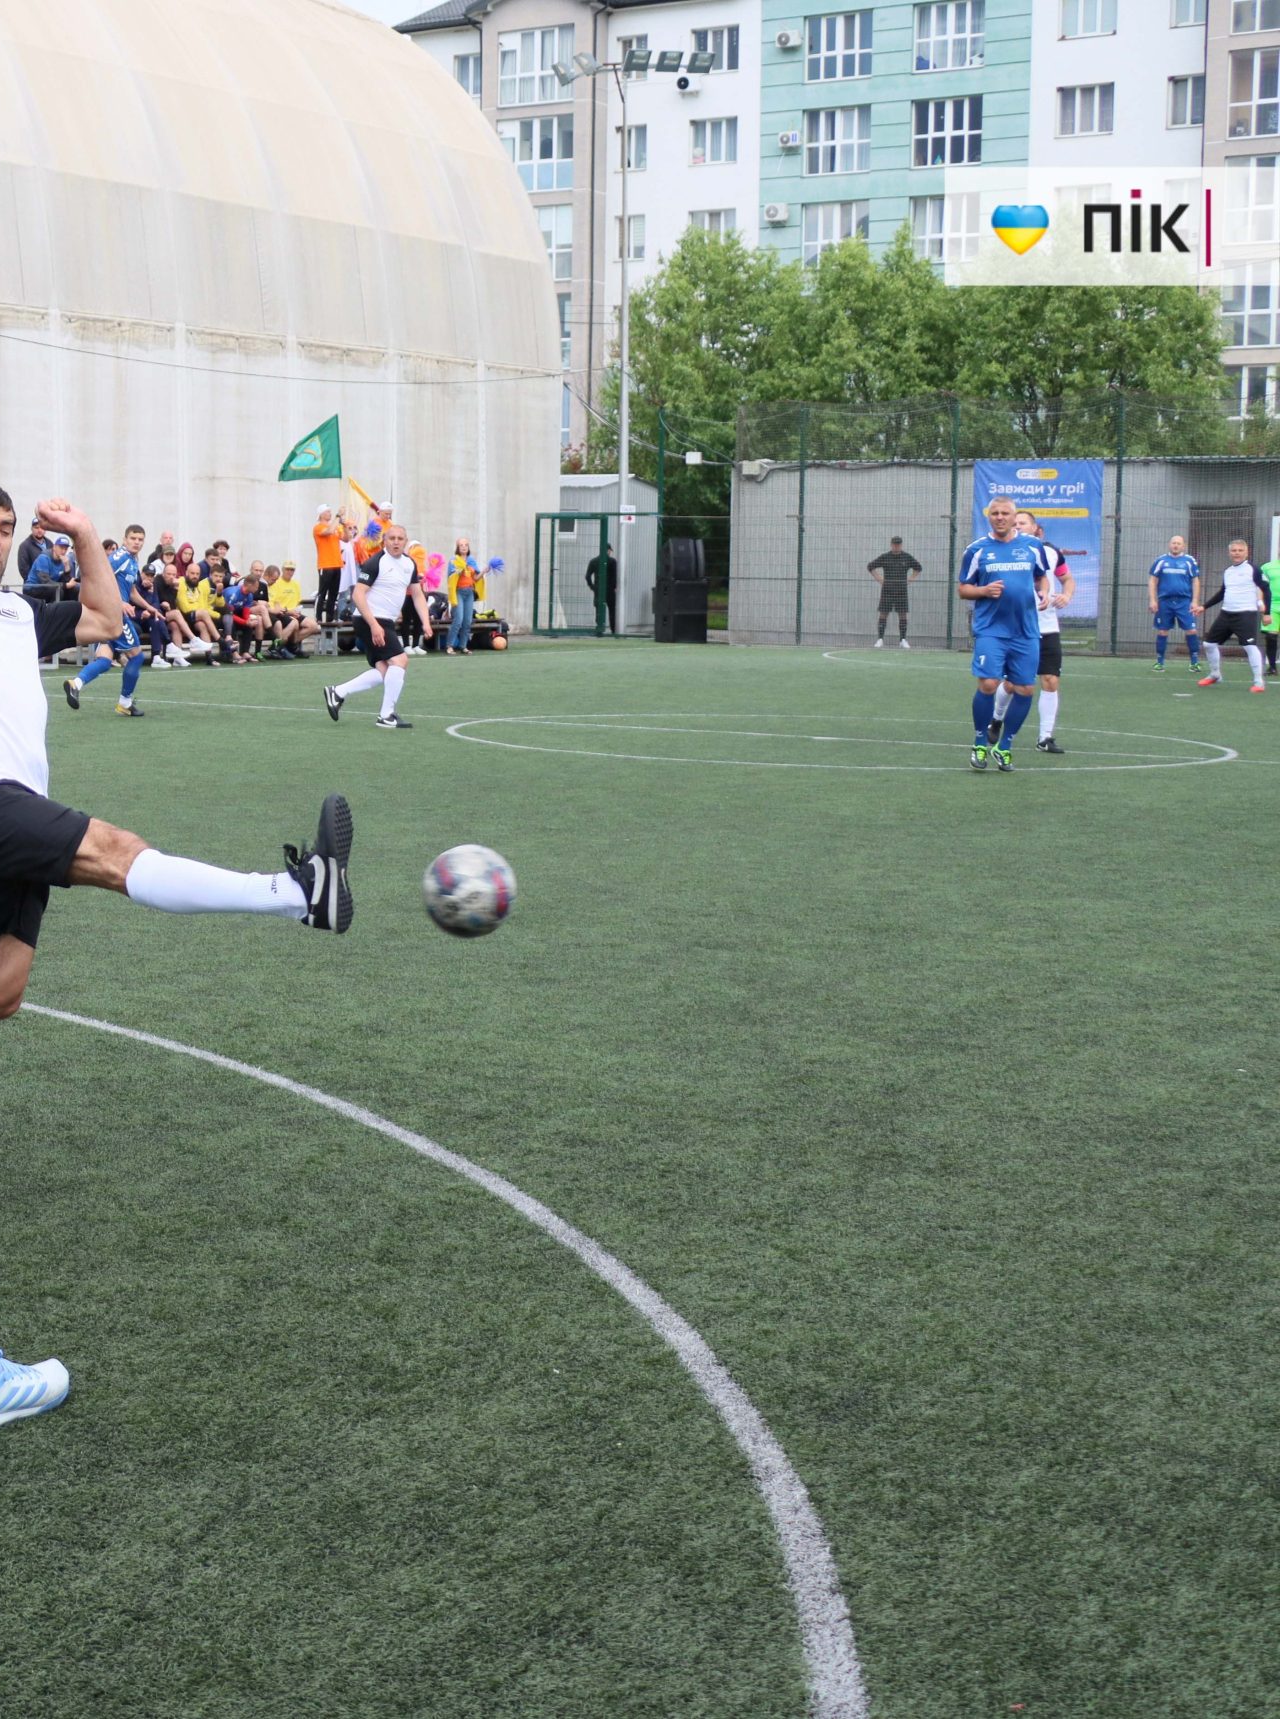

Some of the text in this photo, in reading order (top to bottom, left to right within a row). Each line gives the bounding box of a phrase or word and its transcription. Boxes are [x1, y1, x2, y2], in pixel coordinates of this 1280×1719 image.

[988, 482, 1085, 497] Завжди у грі!
